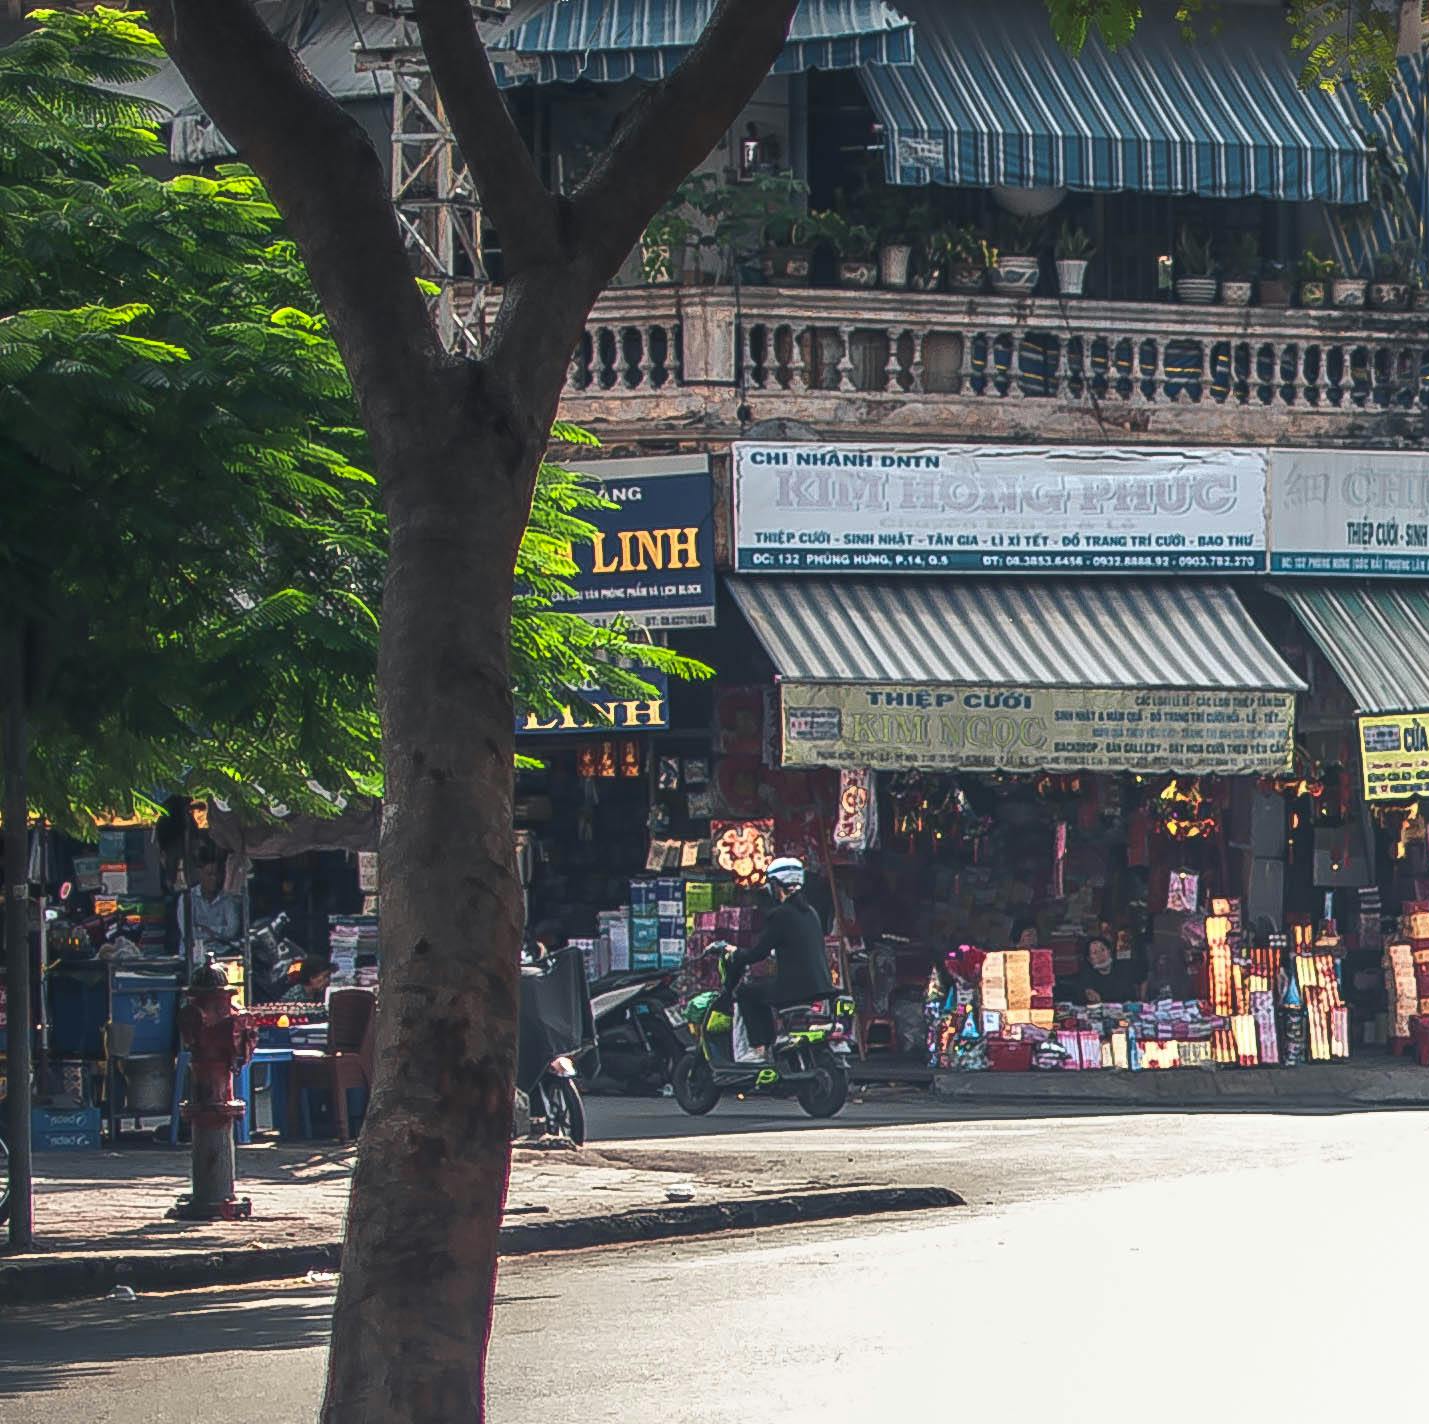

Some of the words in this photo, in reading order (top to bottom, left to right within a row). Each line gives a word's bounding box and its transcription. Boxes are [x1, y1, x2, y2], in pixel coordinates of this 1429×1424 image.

[750, 451, 788, 466] CHI
[880, 455, 940, 469] DNTN
[775, 470, 891, 513] KIM
[755, 531, 796, 546] THIỆP
[799, 530, 831, 545] CƯỚI
[843, 533, 875, 546] SINH
[878, 532, 913, 548] NHẬT
[926, 532, 954, 546] TÂN
[956, 534, 978, 547] GIA
[1024, 532, 1050, 547] TẾT
[1083, 534, 1127, 548] TRANG
[1130, 533, 1152, 548] TRÍ
[1155, 533, 1187, 548] CƯỚI
[1197, 536, 1225, 549] BAO
[1405, 522, 1427, 546] SINH
[592, 527, 701, 574] LINH
[778, 553, 800, 566] 132
[866, 689, 955, 710] THIỆP
[963, 690, 1032, 710] CƯỚI
[851, 711, 934, 748] KIM
